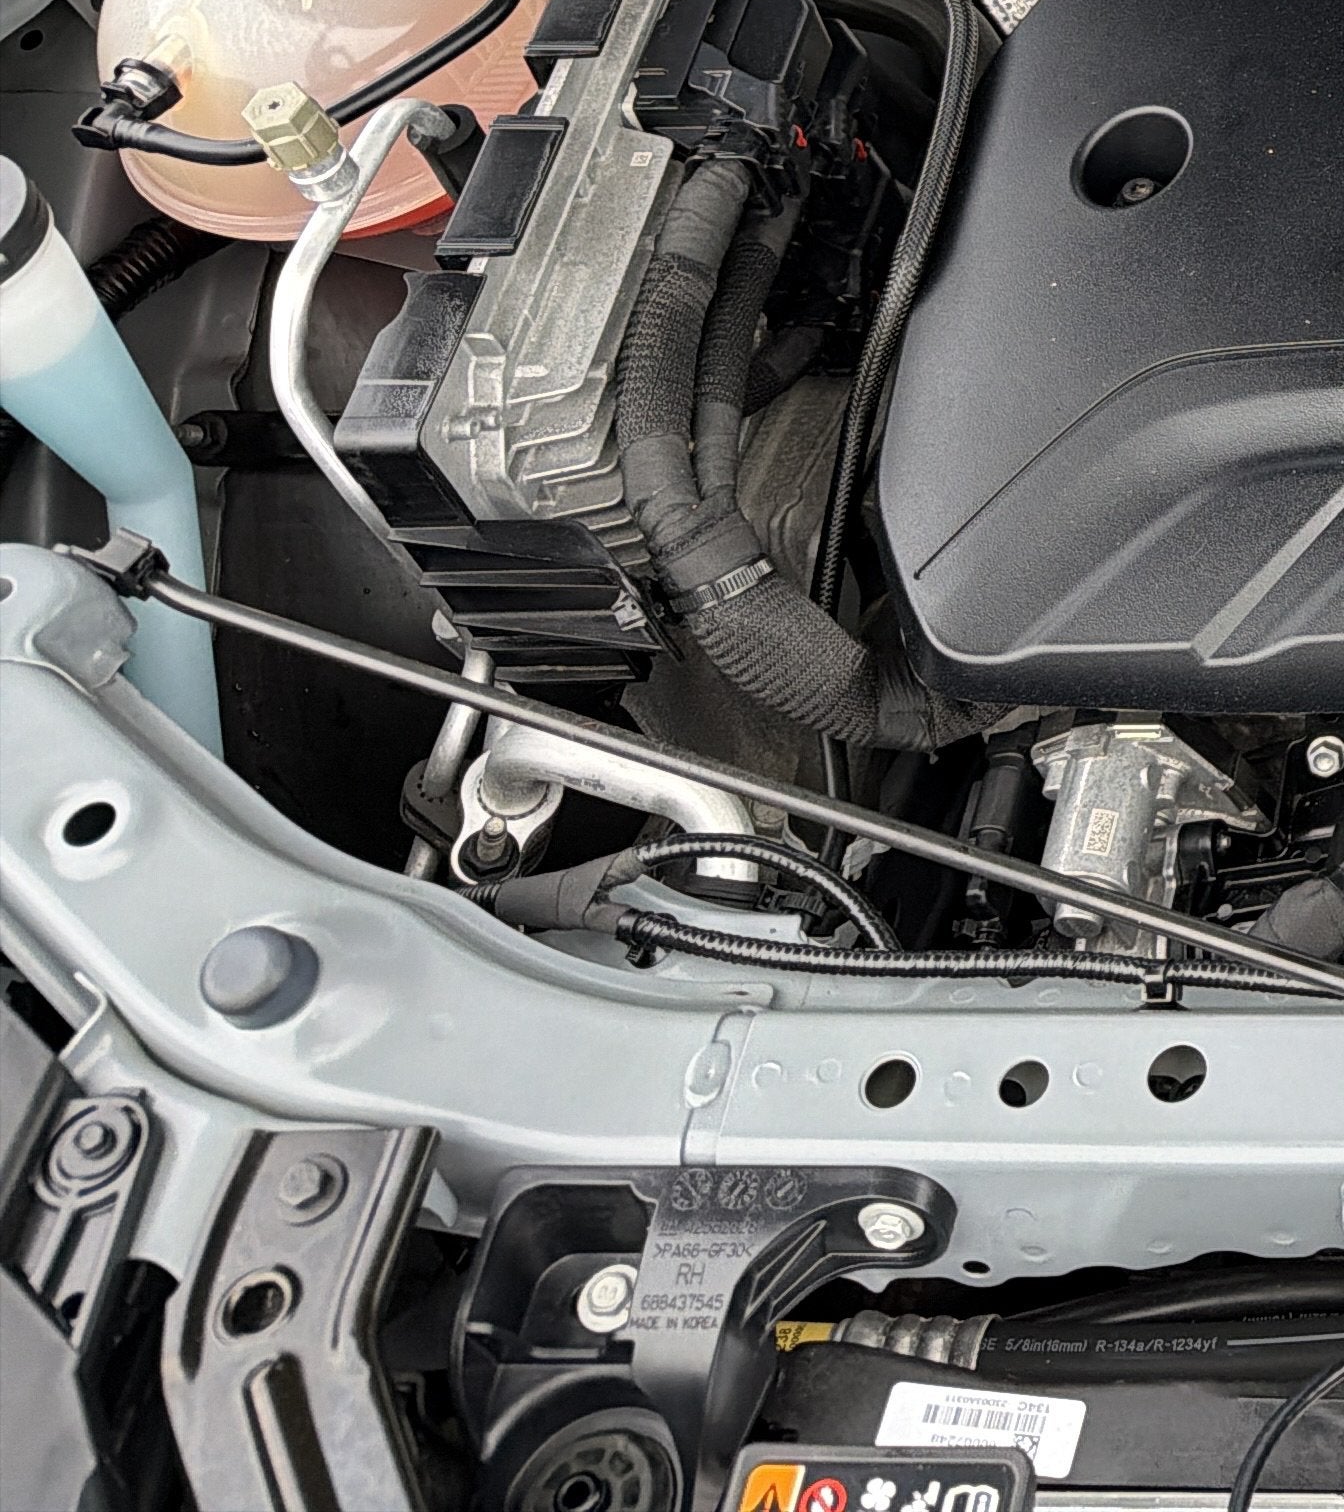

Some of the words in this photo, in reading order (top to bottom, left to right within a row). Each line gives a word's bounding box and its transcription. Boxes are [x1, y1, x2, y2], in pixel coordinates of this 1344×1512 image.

[675, 1262, 707, 1286] RH
[629, 1315, 658, 1331] MADE
[666, 1316, 679, 1330] IN
[682, 1315, 719, 1331] KOREA
[1004, 1337, 1089, 1353] 5/8in(16mm)
[1095, 1336, 1218, 1352] R-134a/R-1234yf
[1016, 1401, 1050, 1414] 134C
